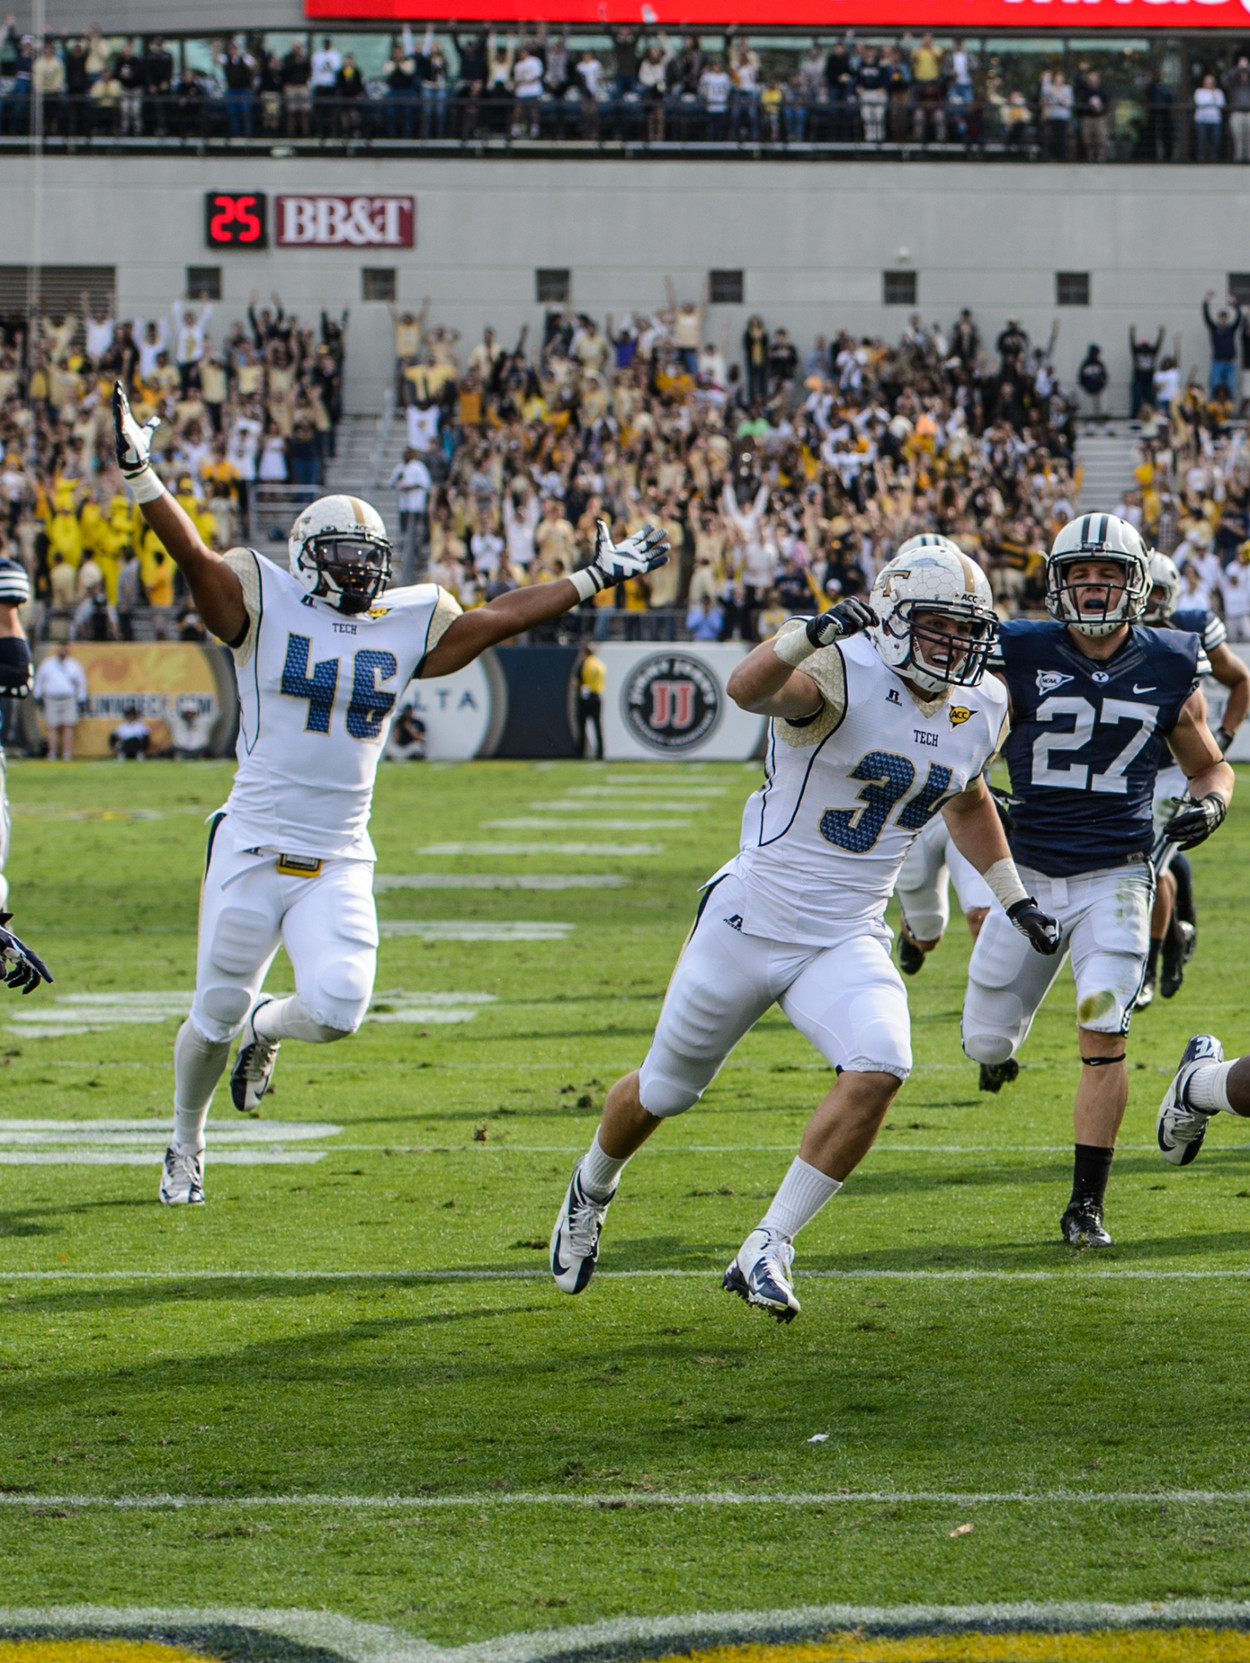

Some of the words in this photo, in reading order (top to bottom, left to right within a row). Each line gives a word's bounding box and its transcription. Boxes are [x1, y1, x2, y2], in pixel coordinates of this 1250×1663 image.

[210, 196, 261, 242] 25
[280, 197, 412, 244] BB&T
[961, 594, 978, 603] ACC
[332, 623, 358, 635] TECH
[279, 631, 399, 743] 46
[413, 689, 478, 711] LTA
[650, 680, 696, 729] JJ
[951, 710, 968, 720] ACC
[914, 729, 939, 747] TECH
[1031, 696, 1160, 793] 27
